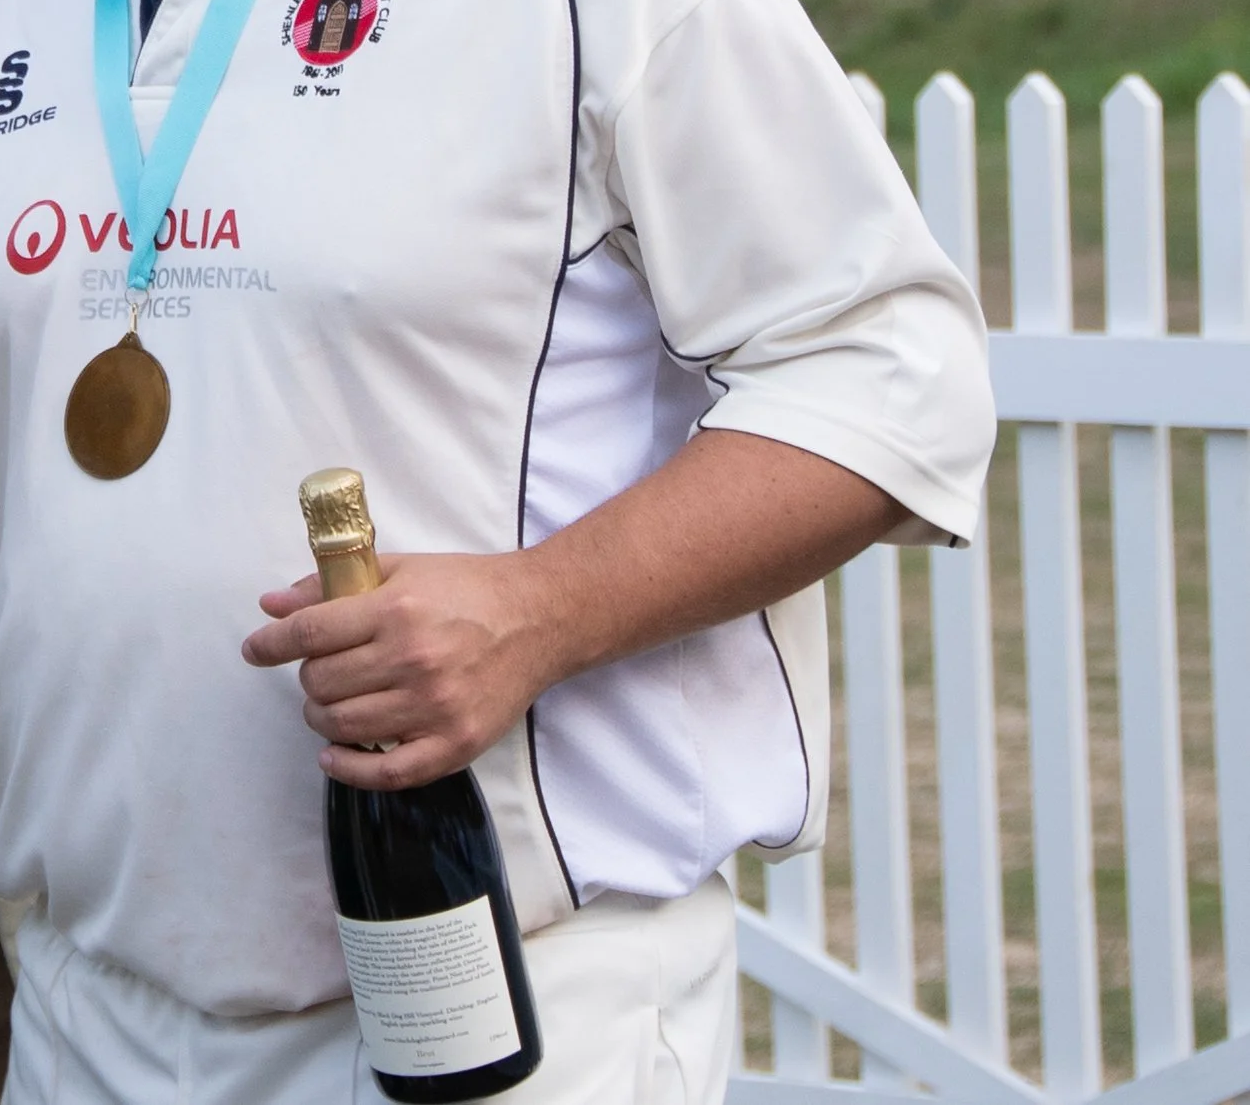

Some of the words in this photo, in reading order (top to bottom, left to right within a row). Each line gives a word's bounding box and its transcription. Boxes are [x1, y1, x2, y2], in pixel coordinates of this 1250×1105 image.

[368, 8, 390, 44] CLUB
[293, 85, 308, 97] 150
[314, 85, 341, 97] Years
[80, 266, 277, 292] ENRONMENTAL
